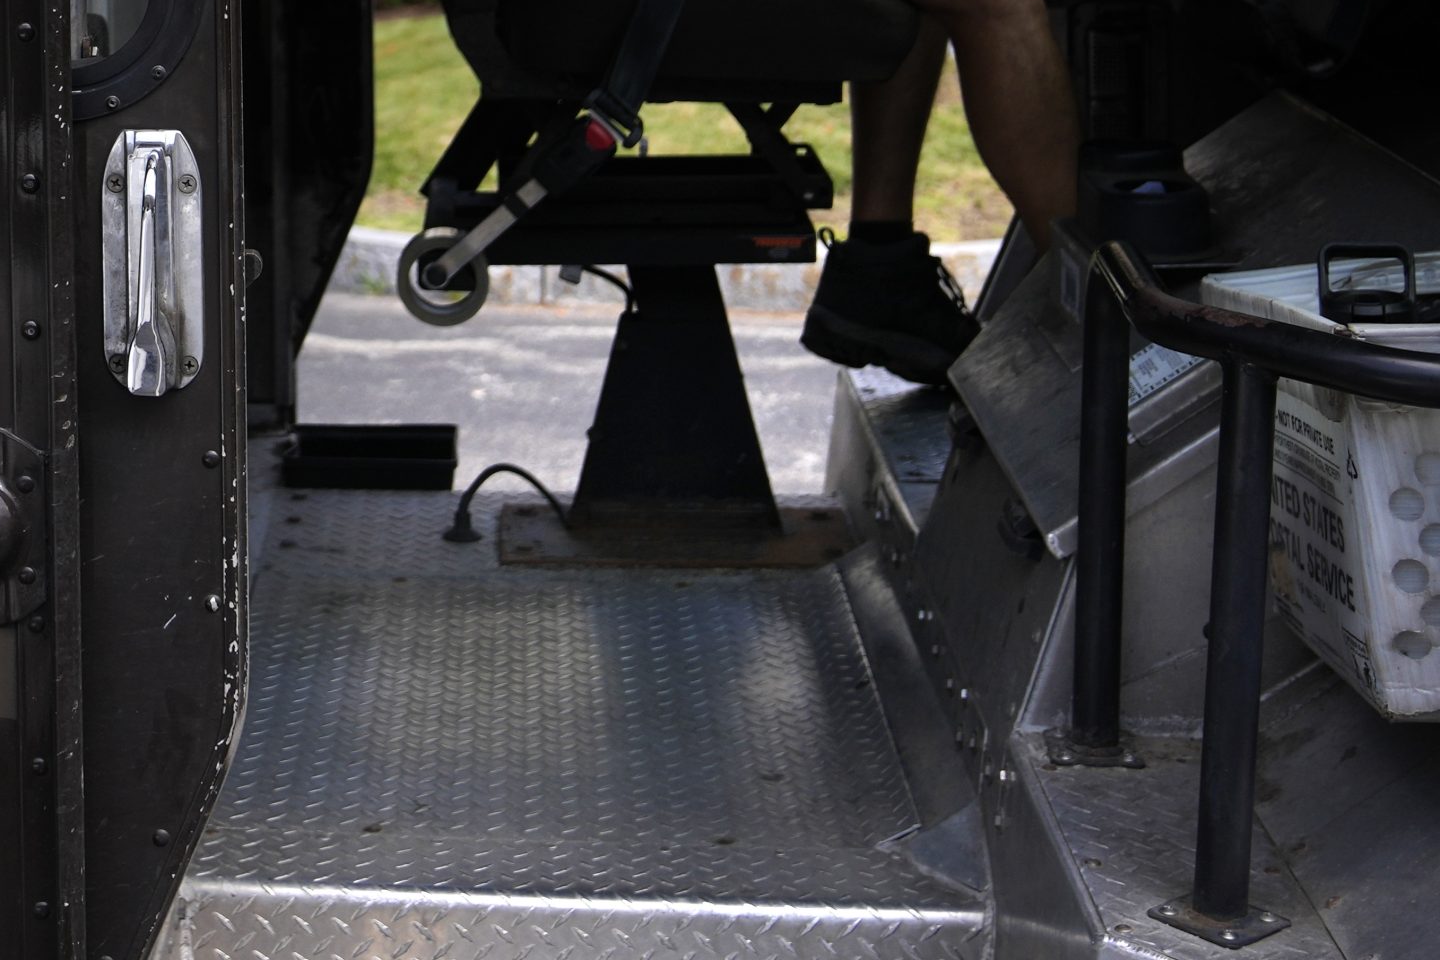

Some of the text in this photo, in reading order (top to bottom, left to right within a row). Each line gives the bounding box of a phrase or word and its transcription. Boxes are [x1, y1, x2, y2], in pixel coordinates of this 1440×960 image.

[1291, 415, 1303, 436] FOR
[1303, 421, 1323, 448] PRIVATE
[1323, 434, 1335, 455] USE
[1303, 491, 1345, 553] STATES
[1270, 517, 1305, 571] OSTAL
[1307, 543, 1356, 613] SERVICE
